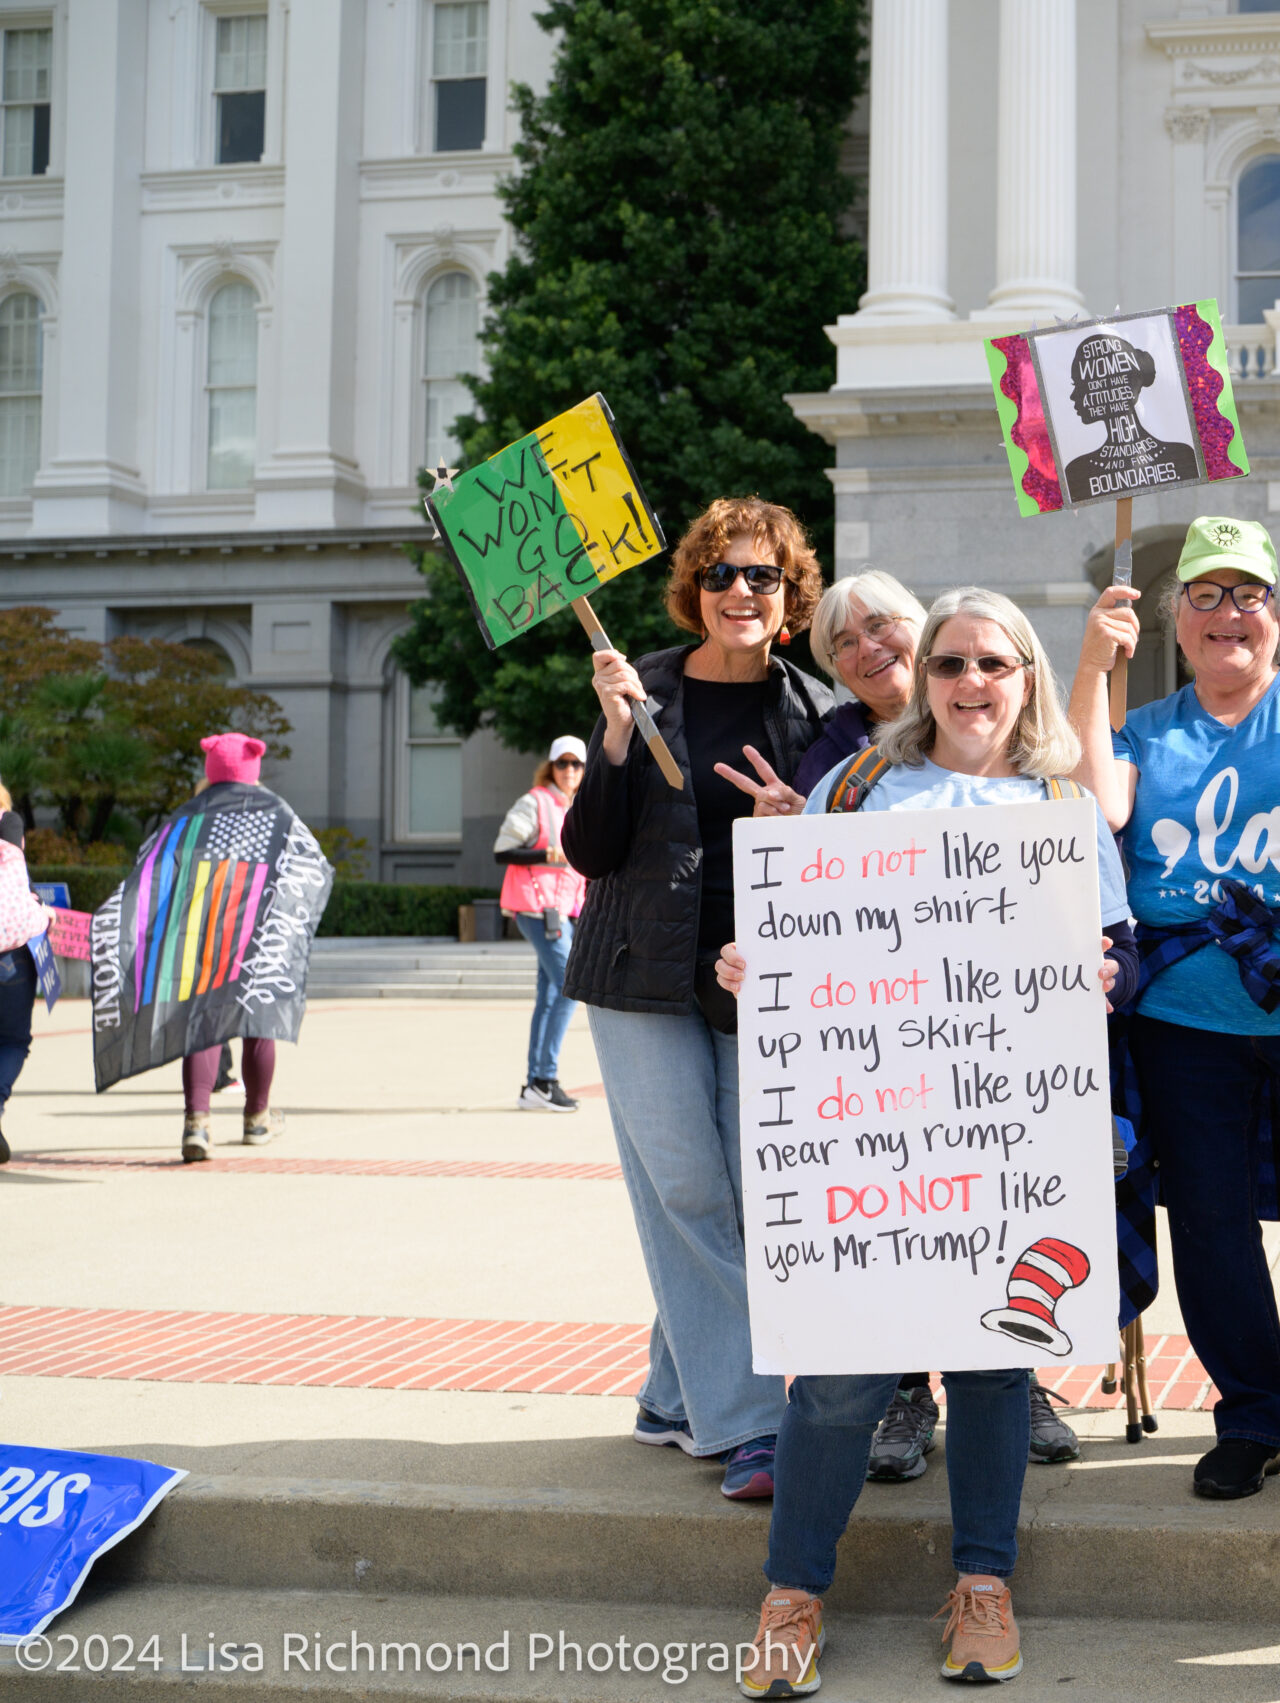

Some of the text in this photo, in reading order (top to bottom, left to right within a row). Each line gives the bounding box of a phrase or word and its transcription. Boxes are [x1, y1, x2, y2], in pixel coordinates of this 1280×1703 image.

[1079, 351, 1141, 380] WOMEN
[1082, 338, 1122, 359] STRONG
[1082, 386, 1136, 407] ATTITUDES.
[1110, 374, 1130, 388] HAVE
[1088, 401, 1130, 418] THEY HAVE
[1109, 414, 1139, 443] HIGH
[472, 431, 568, 504] WE
[1100, 437, 1158, 458] STANDARDS
[1104, 453, 1155, 470] AND FIRM
[1088, 462, 1181, 496] BOUNDARIES.
[458, 451, 602, 558] WON'T
[491, 491, 654, 630] BACK!
[516, 513, 589, 575] GO
[751, 831, 1085, 889] I do not like you
[757, 887, 1018, 952] down my shirt.
[758, 957, 1091, 1013] I do not like you
[757, 1031, 801, 1069] up
[820, 1023, 880, 1072] my
[758, 1061, 1100, 1127] I do not like you
[756, 1121, 1034, 1172] near my rump.
[766, 1171, 1066, 1228] I DO NOT like
[764, 1219, 1008, 1283] you Mr. Trump!
[770, 1598, 791, 1607] HOKA
[970, 1584, 993, 1592] HOKA
